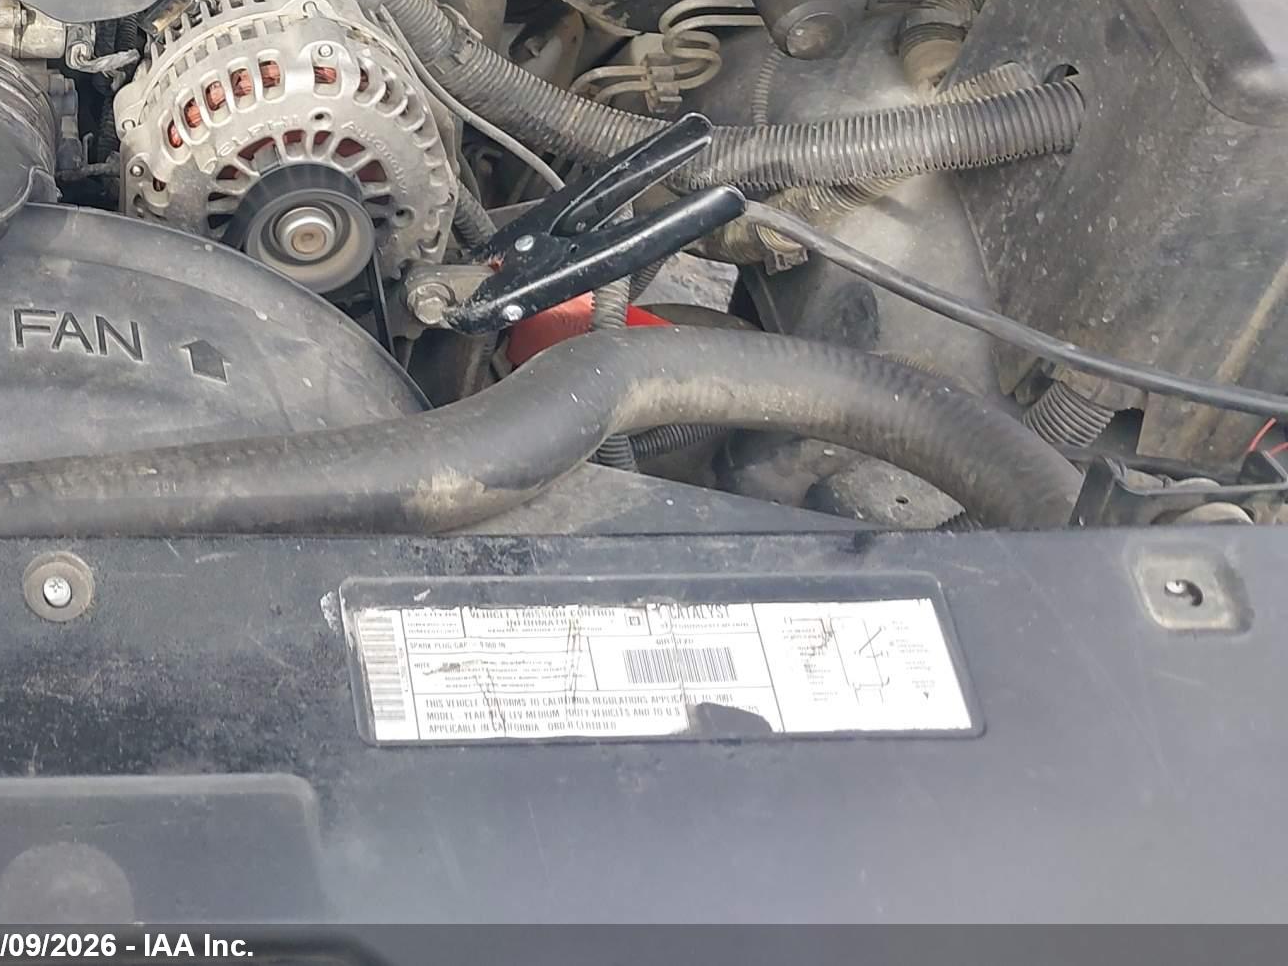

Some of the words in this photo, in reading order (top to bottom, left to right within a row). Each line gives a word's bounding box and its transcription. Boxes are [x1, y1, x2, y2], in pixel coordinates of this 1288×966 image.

[12, 307, 145, 363] FAN
[670, 604, 730, 619] CATALYST
[446, 698, 478, 708] VEHICLE
[525, 709, 560, 719] MEDIUM
